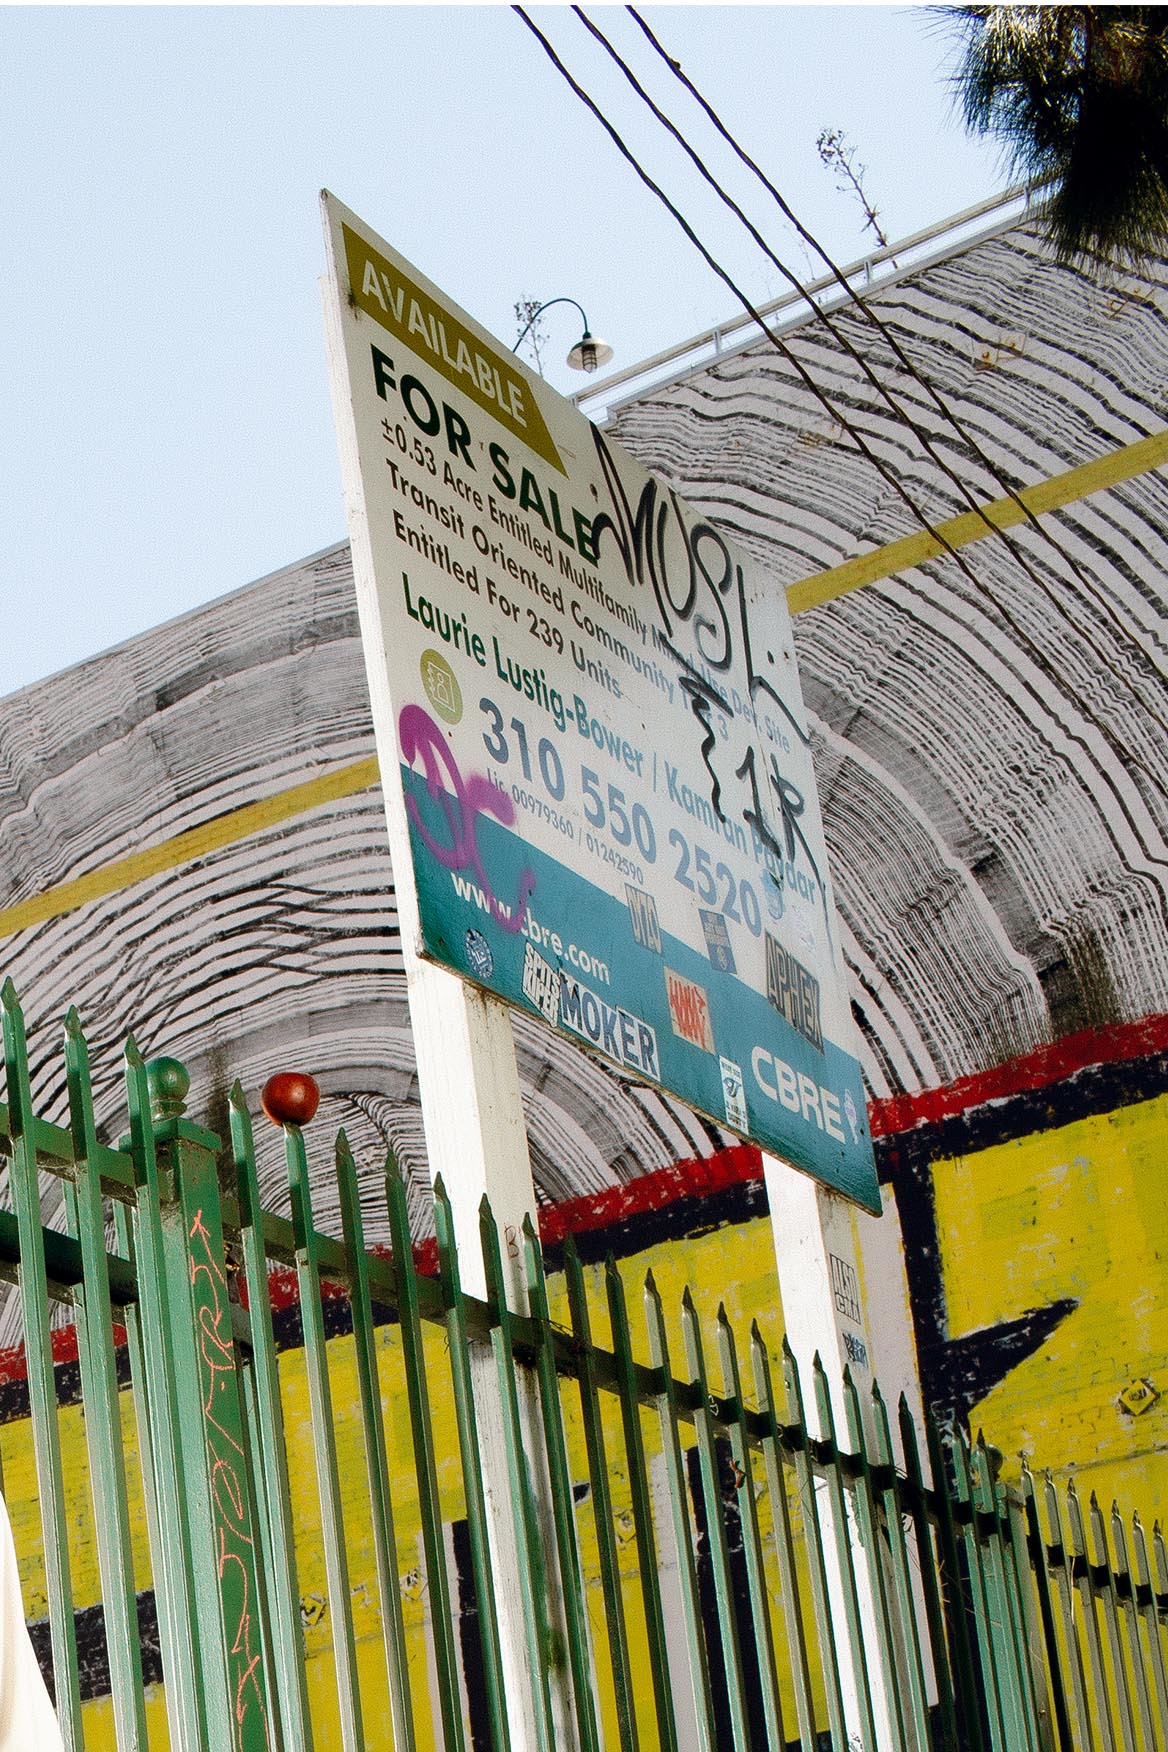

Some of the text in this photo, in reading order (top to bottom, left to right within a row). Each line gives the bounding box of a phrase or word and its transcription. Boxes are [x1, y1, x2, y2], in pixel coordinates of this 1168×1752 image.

[362, 259, 528, 428] AVAILABLE
[370, 343, 598, 568] FOR SALE
[381, 418, 437, 476] ±0.53
[443, 460, 483, 512] Acre
[488, 494, 554, 567] Entitled
[559, 550, 647, 645] Multifamily
[764, 715, 790, 754] Site
[386, 458, 465, 539] Transit
[472, 525, 565, 615] Oriented
[571, 600, 674, 704] Community
[717, 714, 729, 741] 3
[393, 508, 622, 699] Entitled For 239 Units
[402, 571, 486, 667] Laurie
[492, 635, 644, 777] Lustig-Bower
[479, 697, 566, 802] 310
[581, 763, 657, 865] 550
[668, 828, 762, 938] 2520
[512, 783, 574, 839] 00979360
[586, 833, 644, 885] 01242590
[450, 871, 611, 986] wwwcbre.com
[560, 972, 659, 1080] MOKER
[751, 1046, 846, 1145] CBRE
